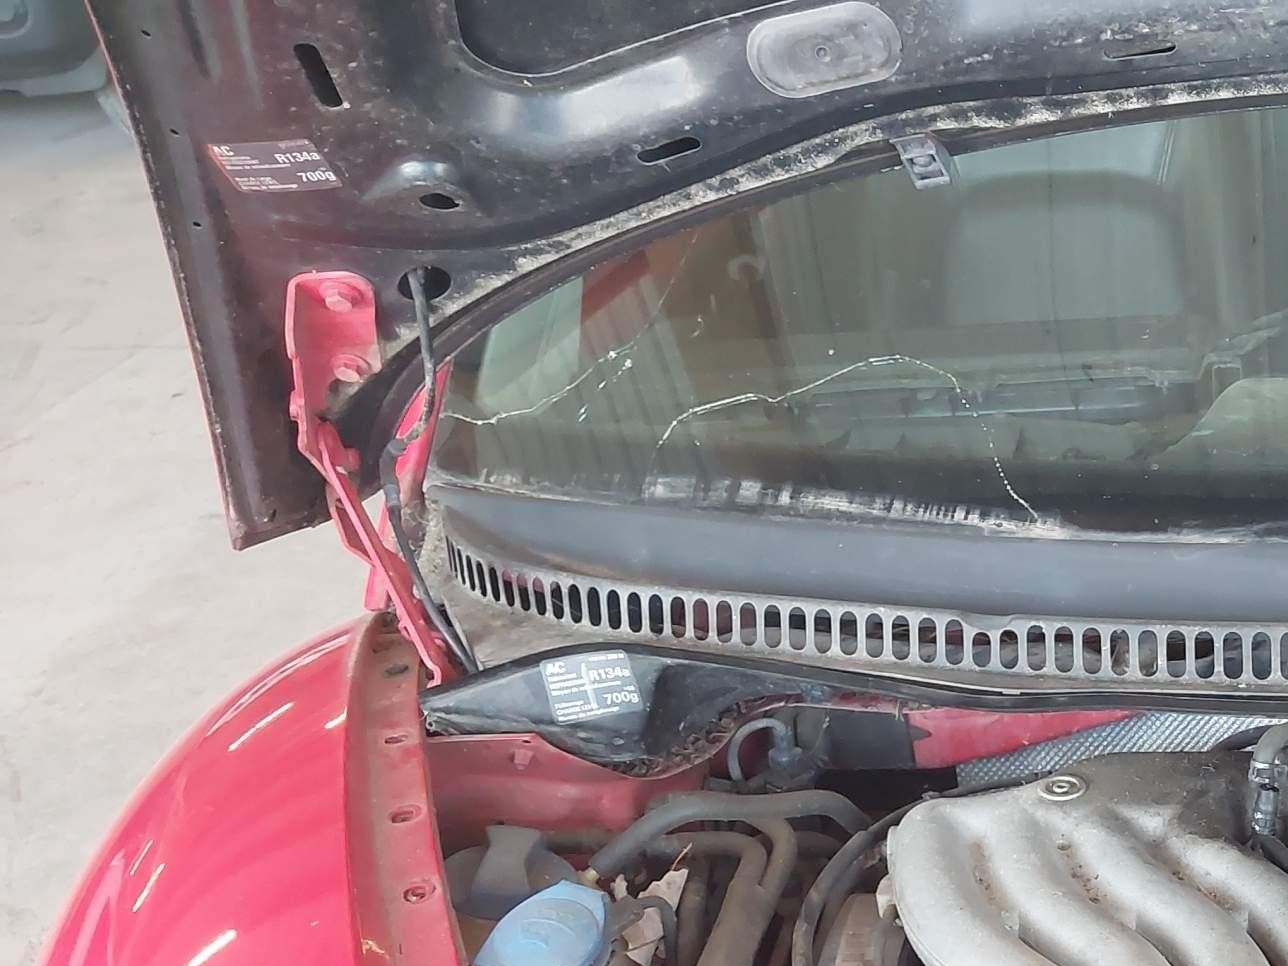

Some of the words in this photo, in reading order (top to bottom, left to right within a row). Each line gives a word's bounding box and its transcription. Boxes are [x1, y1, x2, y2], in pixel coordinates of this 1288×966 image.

[212, 146, 234, 156] AC
[274, 151, 320, 164] R134a
[296, 170, 337, 182] 700g
[546, 661, 566, 676] AC
[588, 666, 630, 681] R134a
[603, 691, 640, 705] 700g
